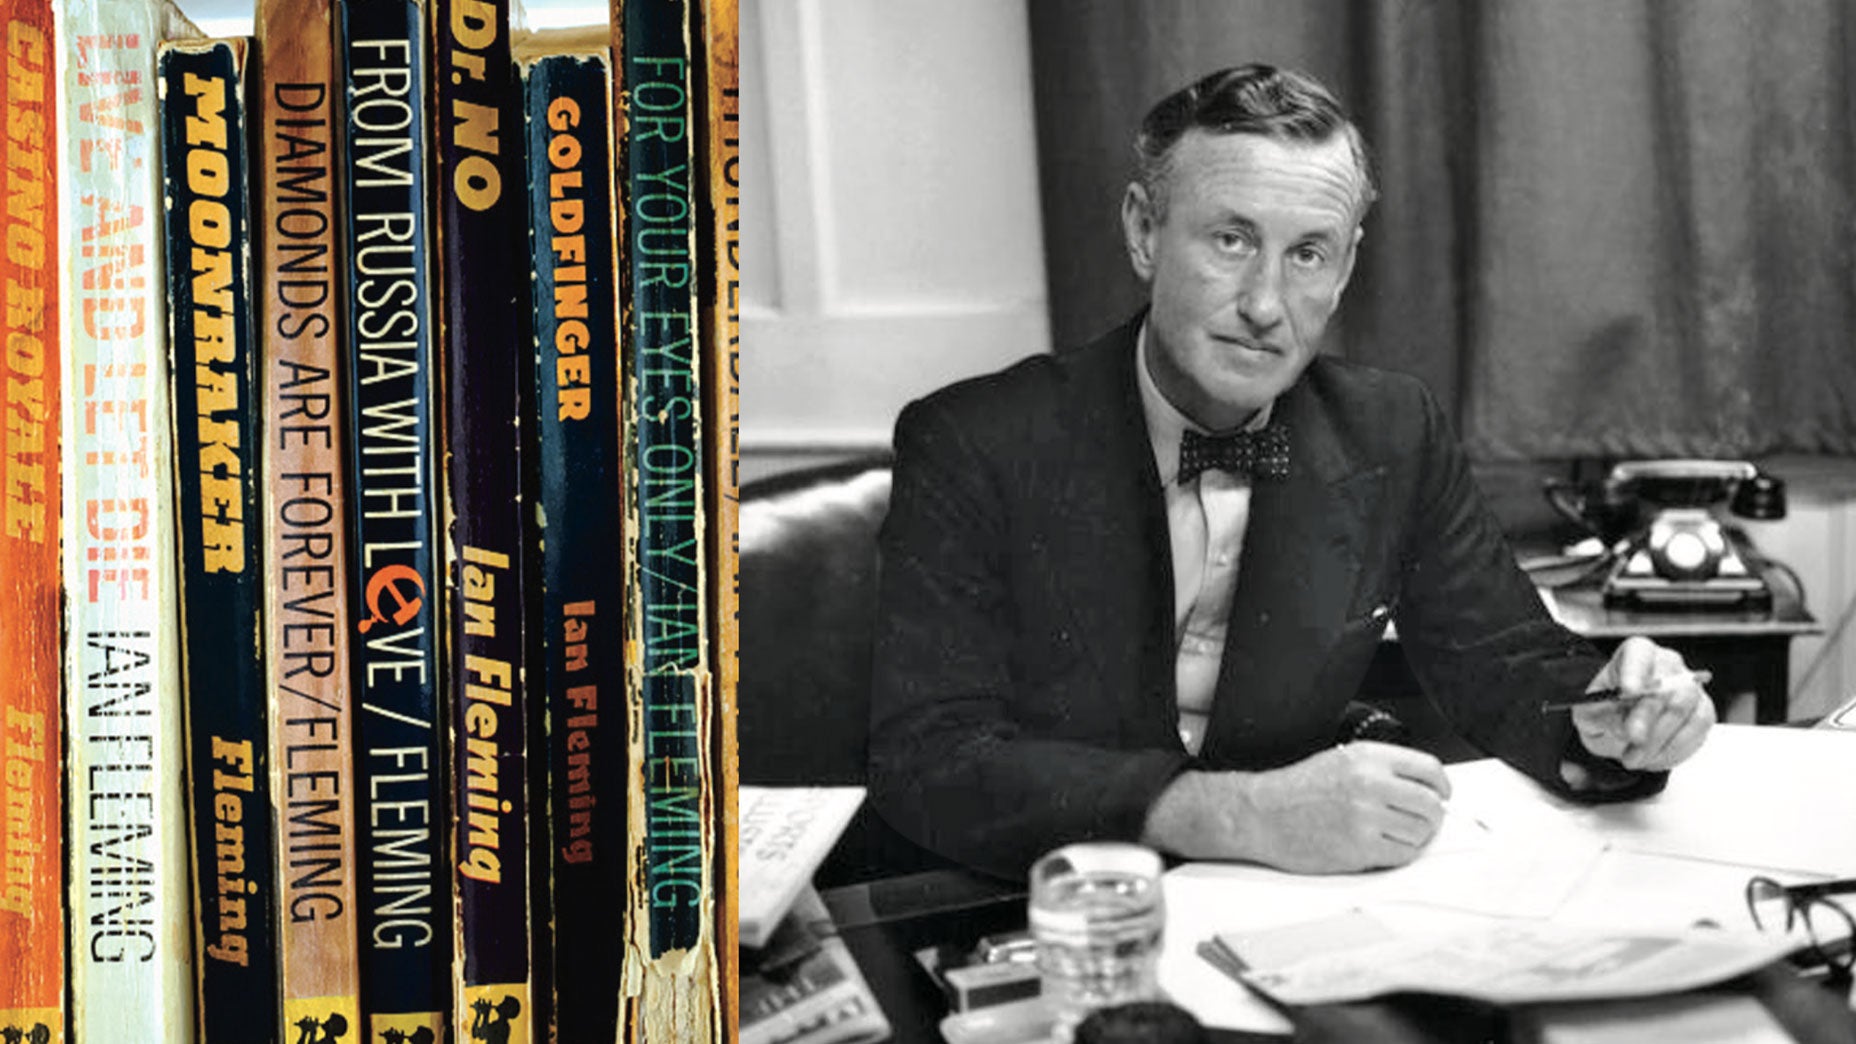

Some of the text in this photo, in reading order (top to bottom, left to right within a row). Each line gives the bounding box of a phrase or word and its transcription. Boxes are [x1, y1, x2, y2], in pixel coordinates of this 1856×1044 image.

[351, 39, 414, 188] FROM
[450, 0, 501, 211] Dr. NO
[633, 56, 685, 144] FOR
[5, 19, 46, 543] CASINO ROYALE
[80, 196, 146, 341] AND
[274, 82, 330, 341] DIAMONDS
[356, 212, 419, 386] RUSSIA
[547, 96, 592, 422] GOLDFINGER
[636, 163, 689, 290] YOUR
[83, 363, 149, 480] LET
[184, 73, 246, 574] MOONRAKER
[280, 360, 332, 451] ARE
[639, 311, 692, 425] EYES
[86, 499, 149, 603] DIE
[361, 398, 423, 519] WITH
[87, 632, 152, 717] IAN
[457, 545, 512, 884] Ian Fleming
[562, 600, 598, 865] Ian Fleming
[6, 705, 46, 919] Fleming
[89, 736, 157, 963] FLEMING
[207, 736, 257, 967] Fleming
[370, 746, 433, 950] FLEMING
[648, 703, 701, 908] FLEMING
